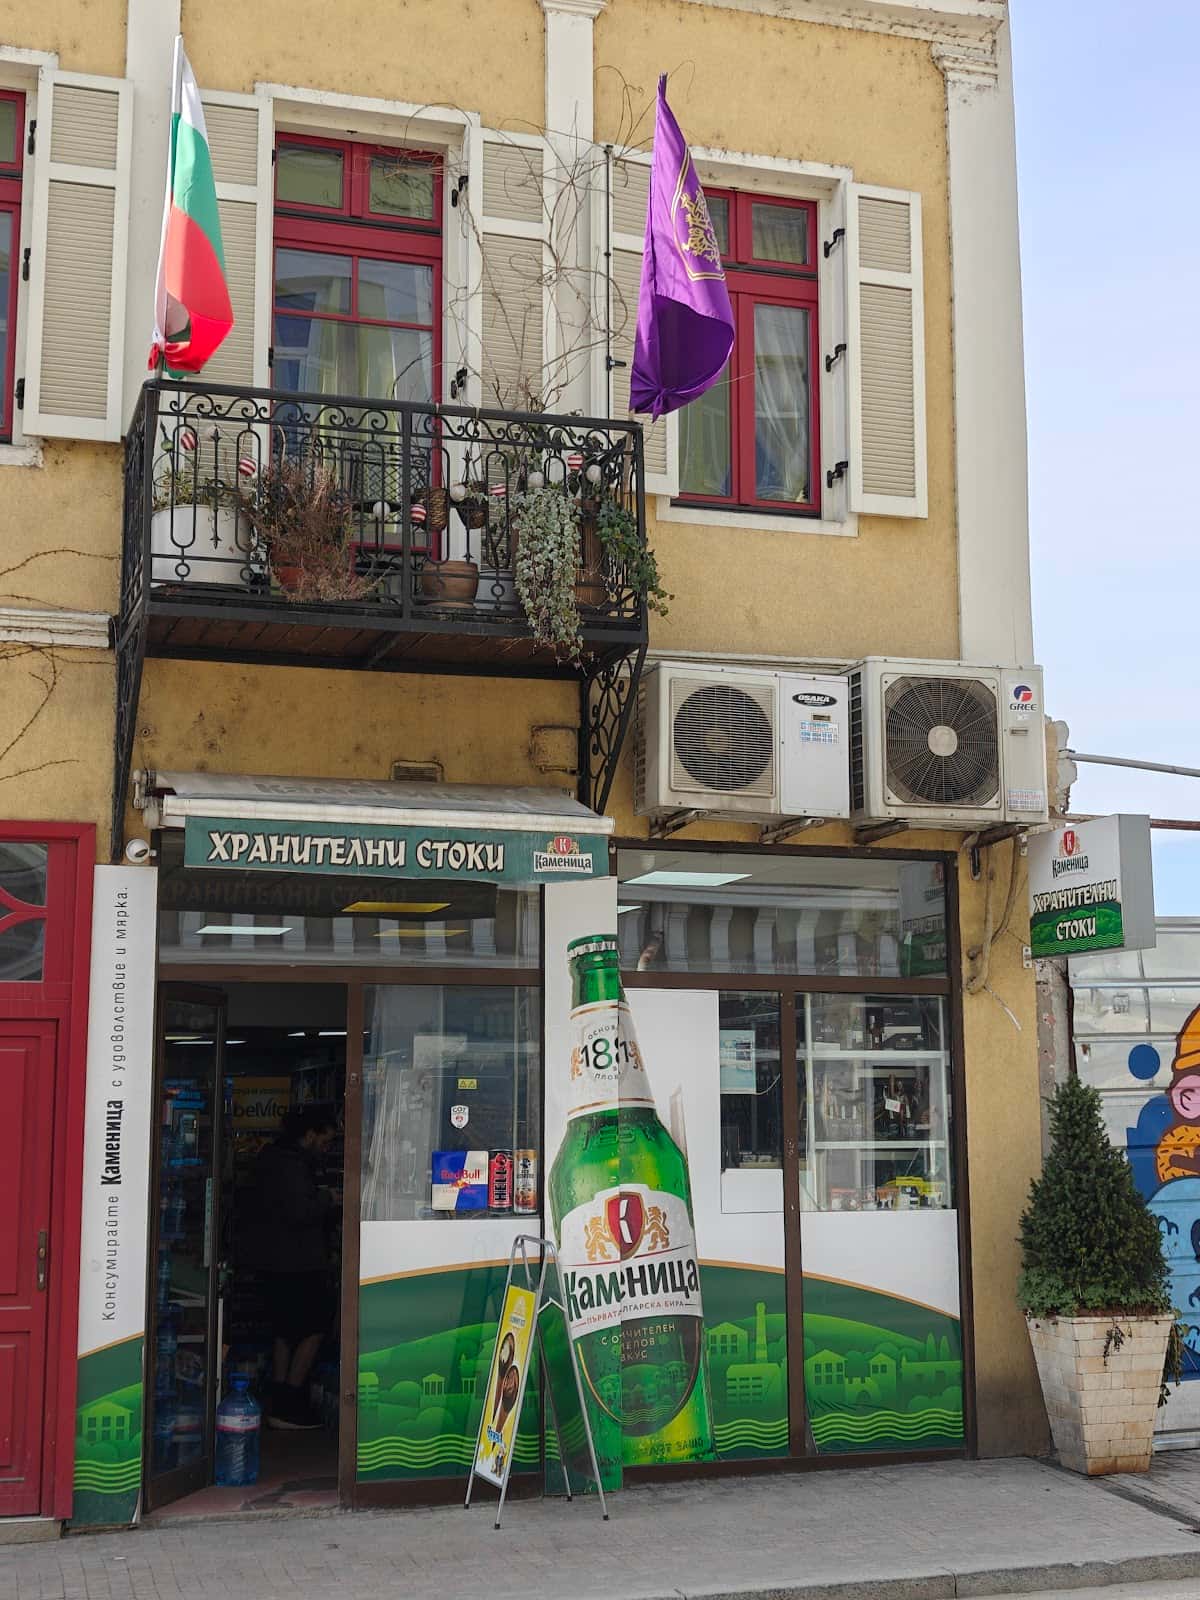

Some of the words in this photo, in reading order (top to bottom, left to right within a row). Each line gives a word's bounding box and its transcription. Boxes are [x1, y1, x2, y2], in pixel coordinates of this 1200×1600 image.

[798, 695, 830, 703] OSAKA
[1009, 703, 1038, 711] GREE
[208, 831, 407, 867] ХРАНИТЕЛНИ
[415, 839, 506, 873] СТОКИ
[535, 854, 592, 870] Каменица
[1052, 855, 1089, 878] Каменица
[1033, 879, 1117, 913] ХРАНИТЕЛНИ
[115, 887, 129, 939] мярка.
[1056, 916, 1096, 940] СТОКИ
[111, 963, 126, 1072] удоволствие
[112, 1079, 123, 1088] с
[101, 1099, 125, 1185] Каменица
[463, 1168, 480, 1179] Bull
[494, 1169, 508, 1201] HELL
[102, 1195, 120, 1321] Консумирайте
